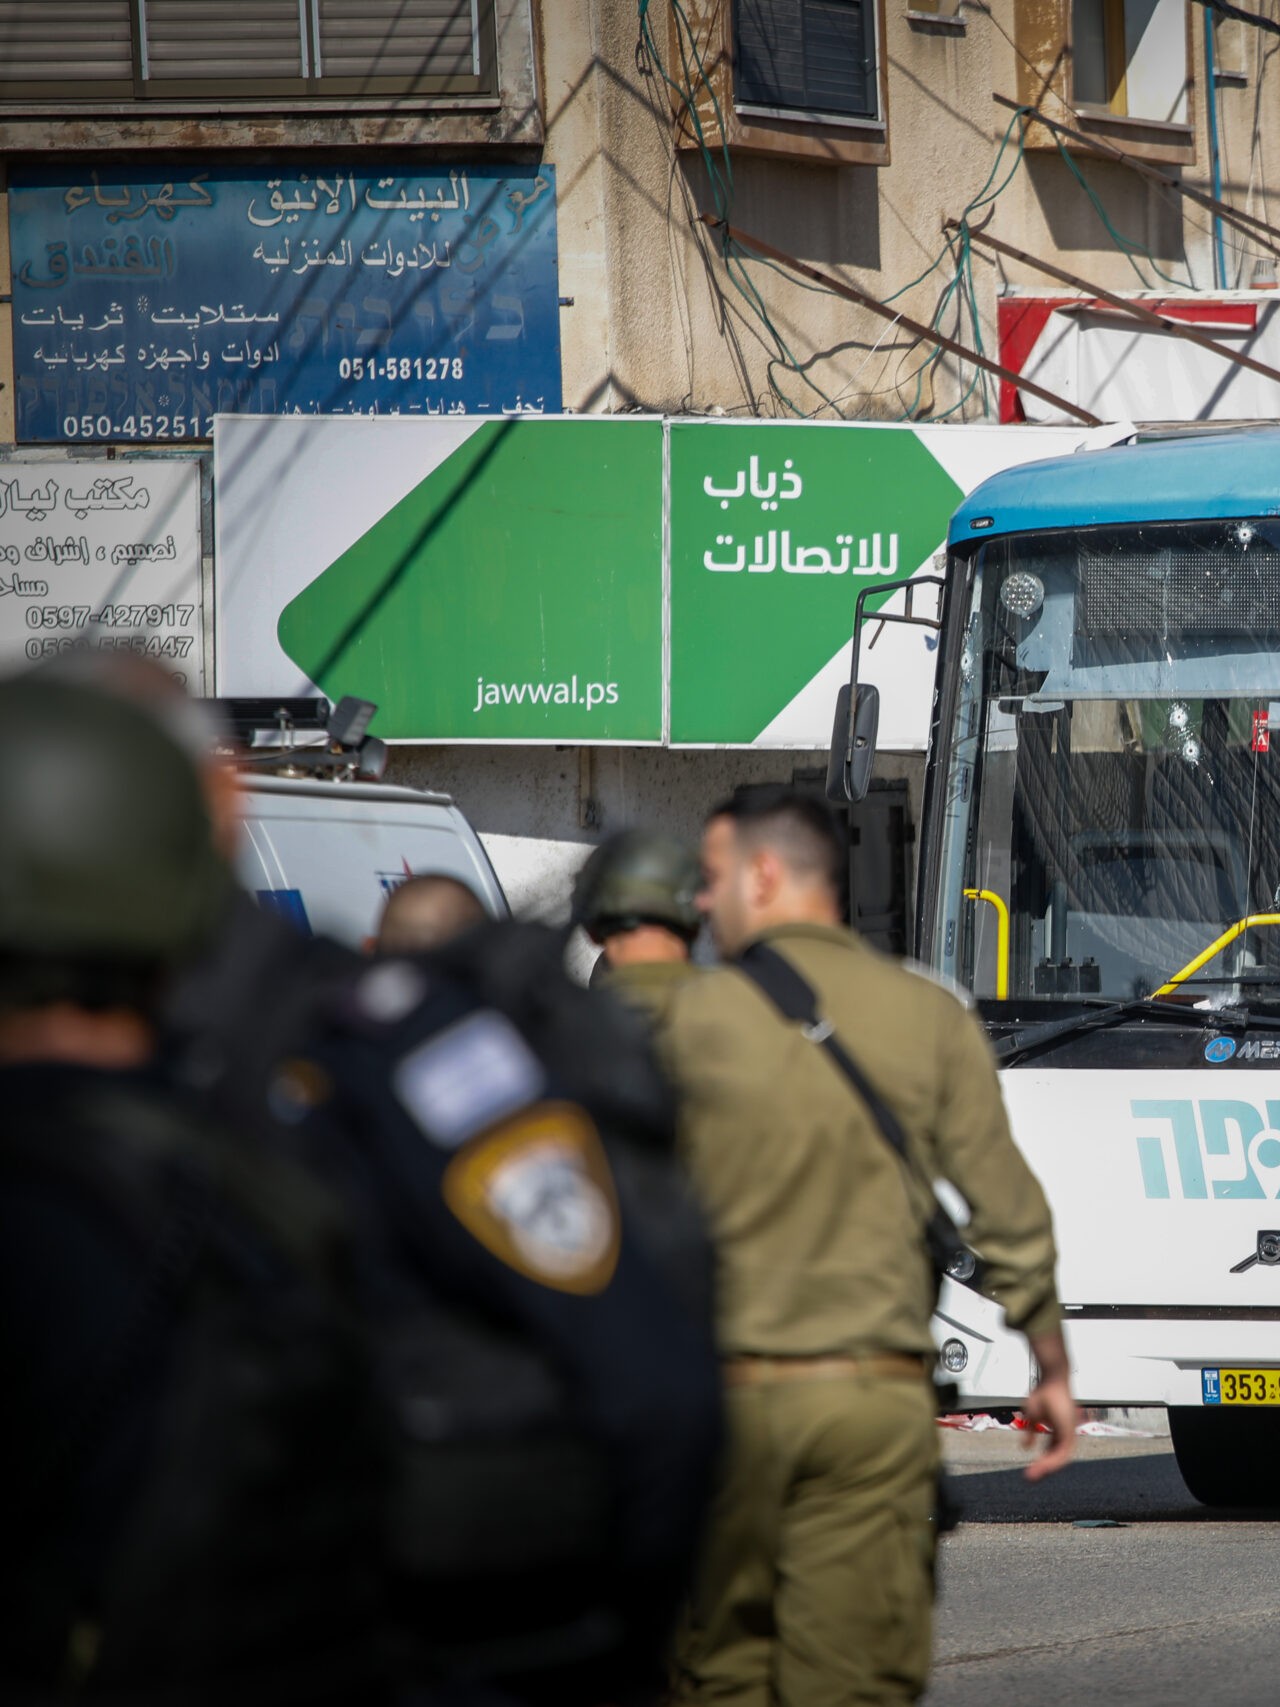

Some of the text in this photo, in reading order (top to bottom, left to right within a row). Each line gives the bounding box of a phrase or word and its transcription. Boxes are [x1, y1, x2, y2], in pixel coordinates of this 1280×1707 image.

[64, 170, 213, 222] كهرباء
[247, 168, 471, 228] البيت الانيق
[18, 235, 174, 289] الفندق
[251, 236, 451, 277] للادوات المنزليه
[20, 302, 280, 332] ستلايت ثريات
[220, 338, 280, 369] ادوات
[338, 357, 464, 381] 051-581278
[65, 476, 150, 520] مكتب
[702, 455, 803, 511] ذياب
[702, 529, 899, 577] للاتصالات
[26, 604, 194, 629] 0597-427917
[473, 675, 620, 713] jawwal.ps
